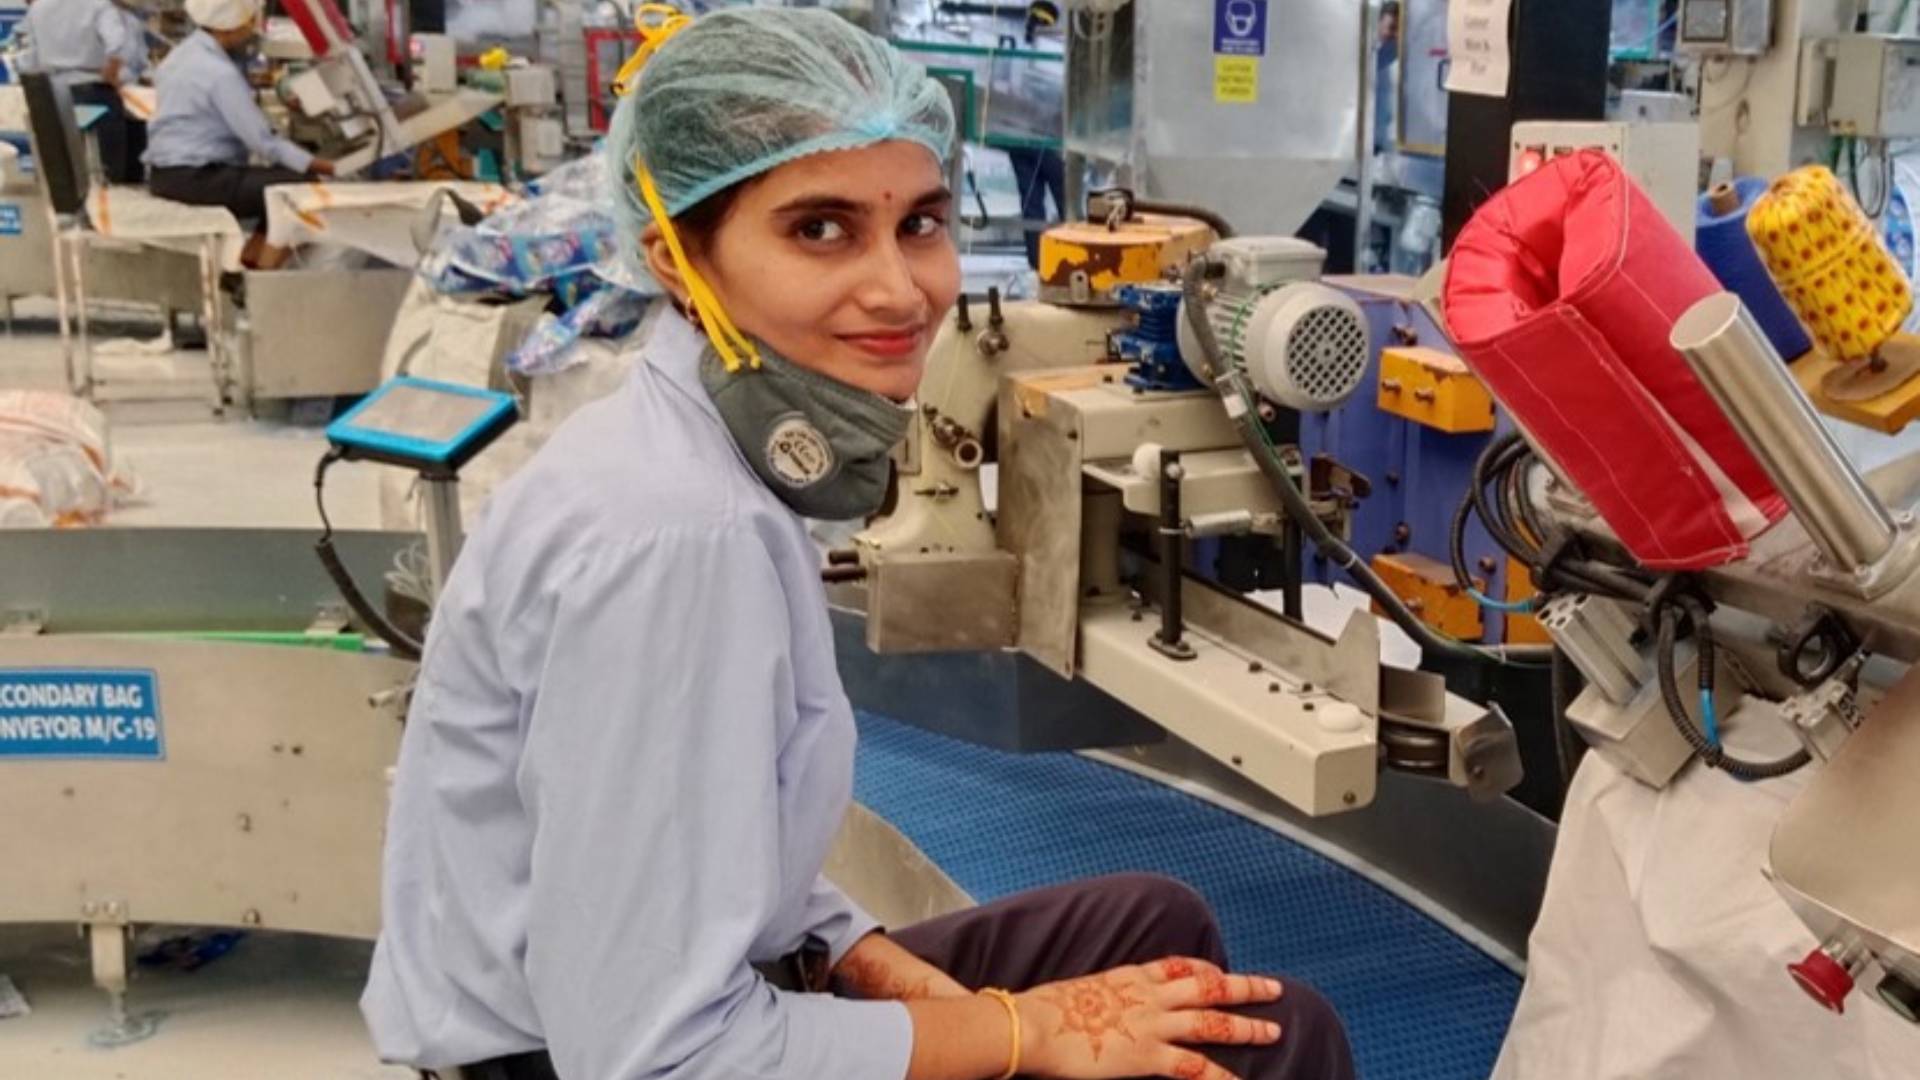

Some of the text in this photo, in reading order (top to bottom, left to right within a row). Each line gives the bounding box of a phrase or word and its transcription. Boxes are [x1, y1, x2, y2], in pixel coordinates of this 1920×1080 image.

[0, 684, 142, 709] CONDARY BAG
[0, 715, 156, 744] NVEYOR M/C-19
